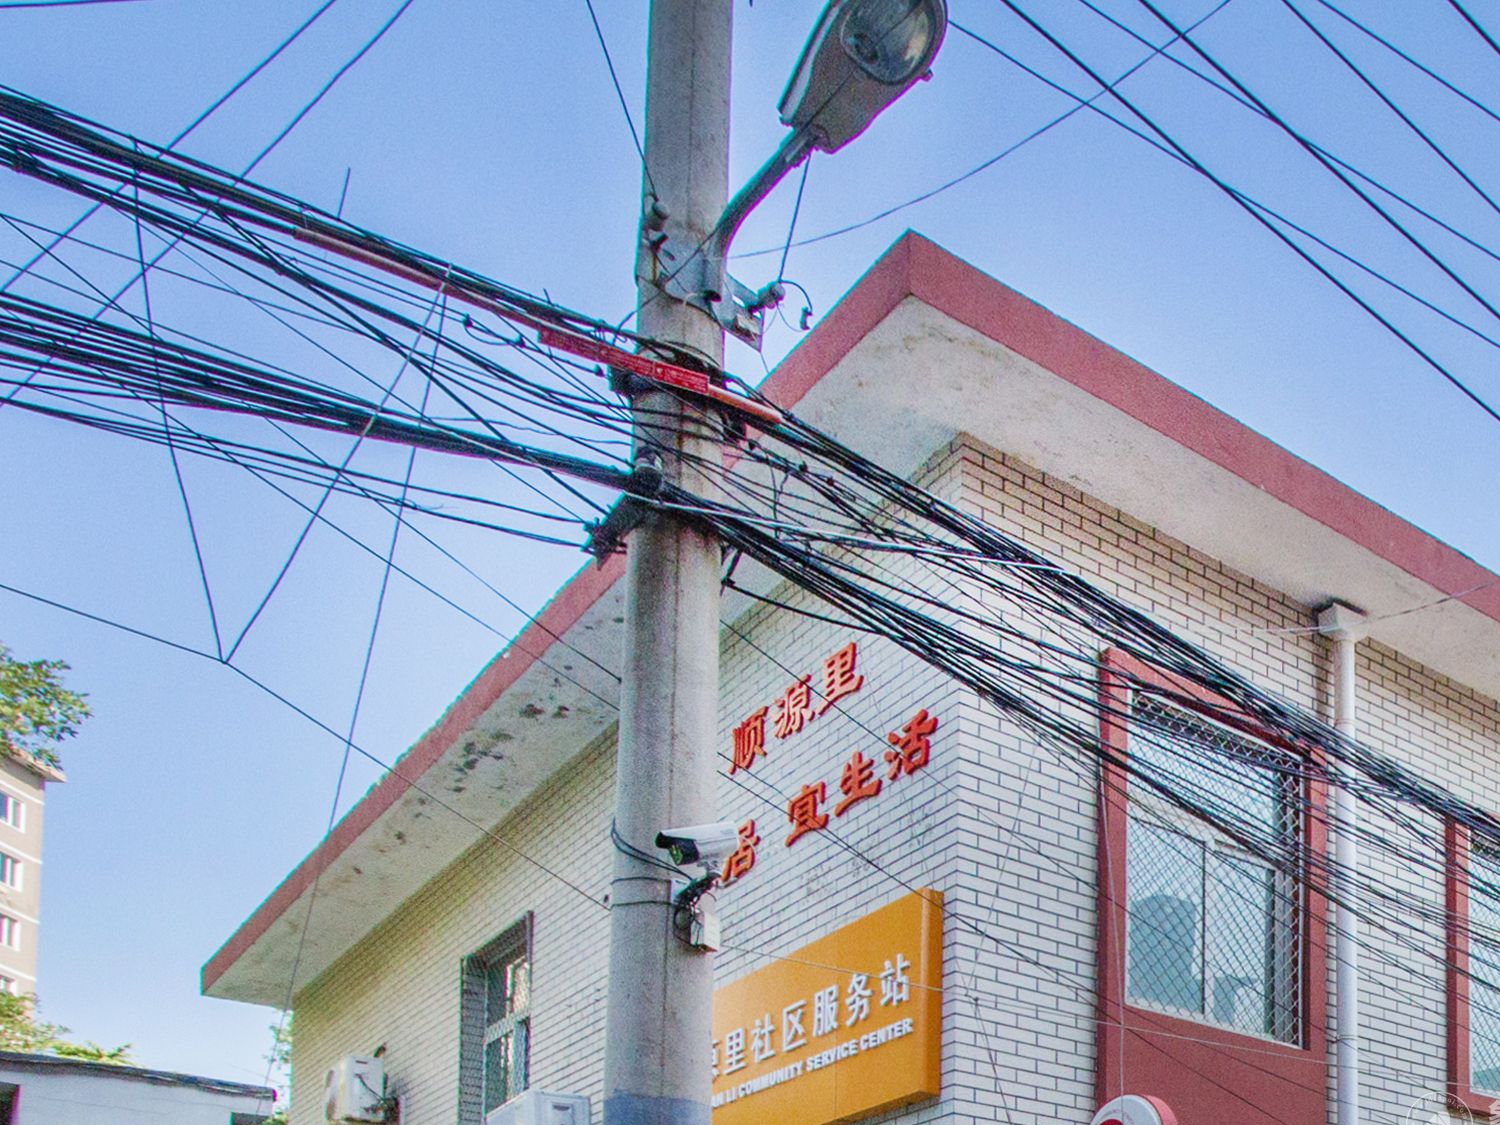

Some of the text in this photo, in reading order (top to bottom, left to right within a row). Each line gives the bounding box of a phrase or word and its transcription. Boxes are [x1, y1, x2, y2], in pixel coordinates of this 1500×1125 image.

[728, 642, 864, 776] 顺源里
[738, 1061, 804, 1098] COMMUNITY
[806, 1039, 859, 1072] SERVICE
[860, 1018, 913, 1051] CENTER
